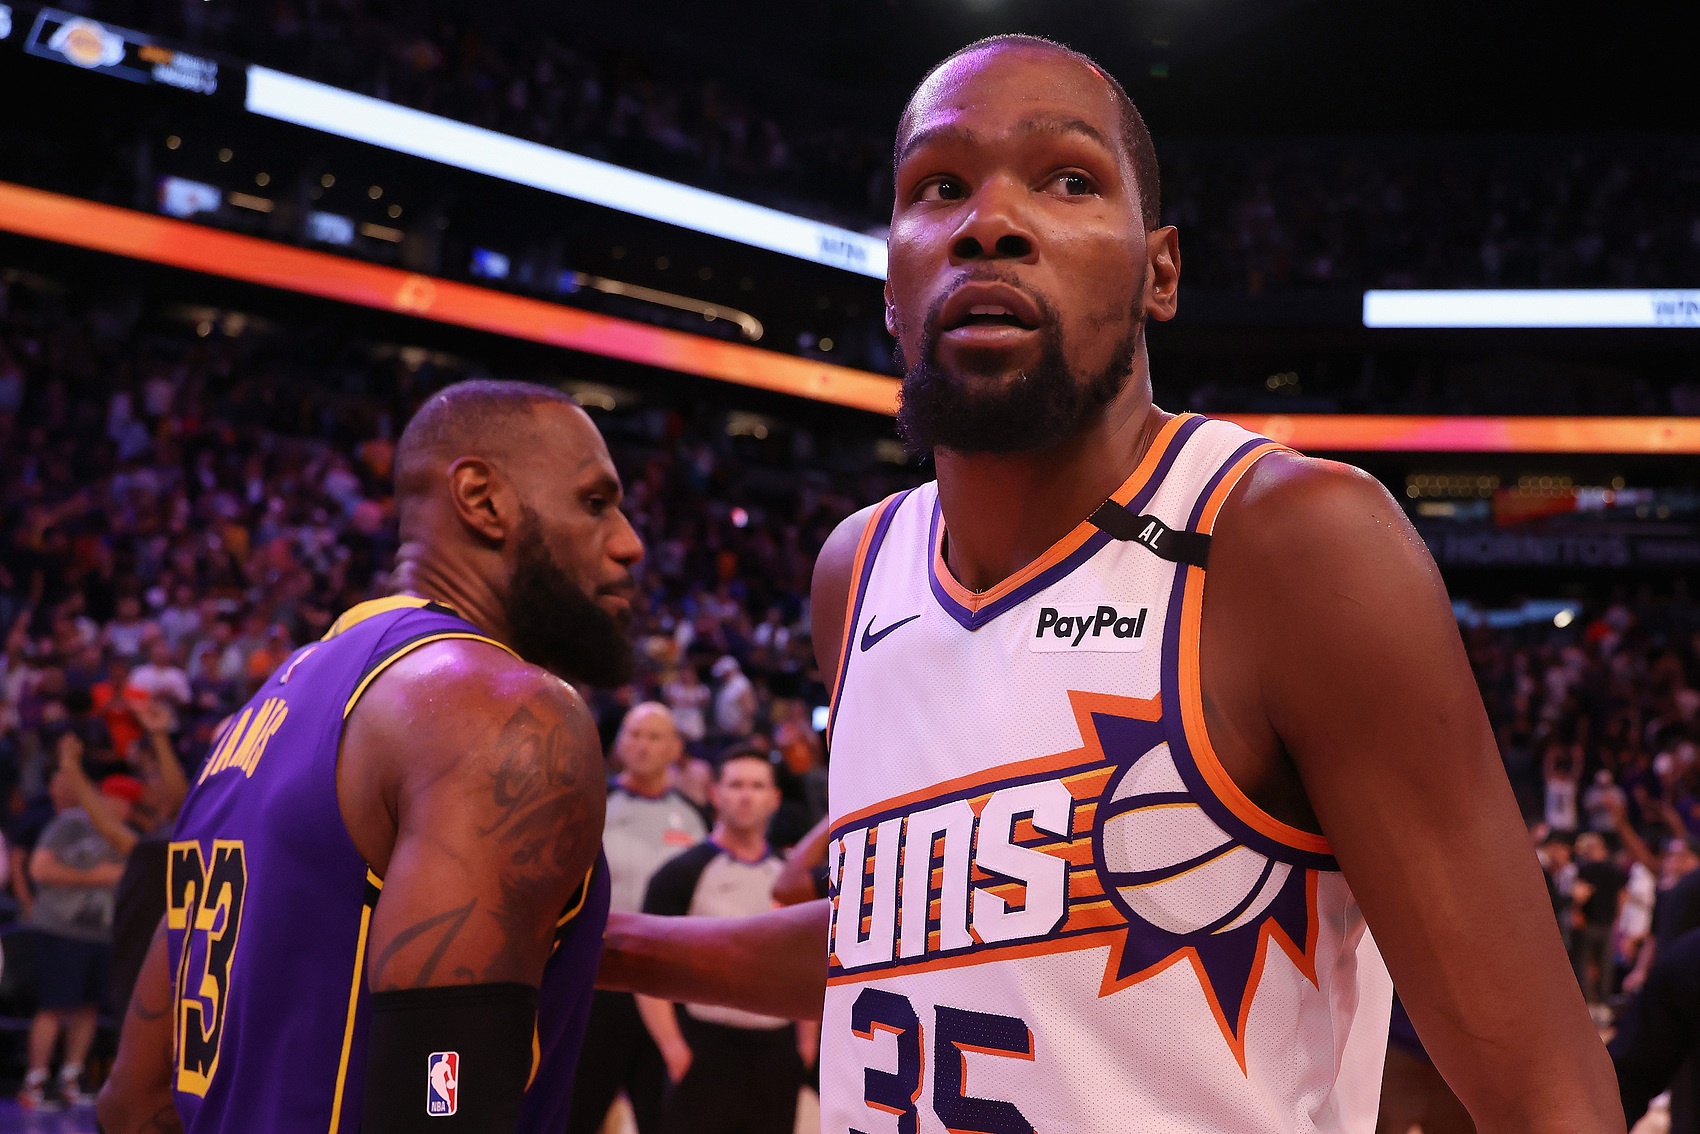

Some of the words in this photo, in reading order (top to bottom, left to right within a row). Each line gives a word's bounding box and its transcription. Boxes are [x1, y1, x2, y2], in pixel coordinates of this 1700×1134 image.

[1138, 521, 1165, 550] AL
[1036, 606, 1148, 648] PayPal
[850, 987, 1038, 1134] 35
[430, 1100, 446, 1112] NBA
